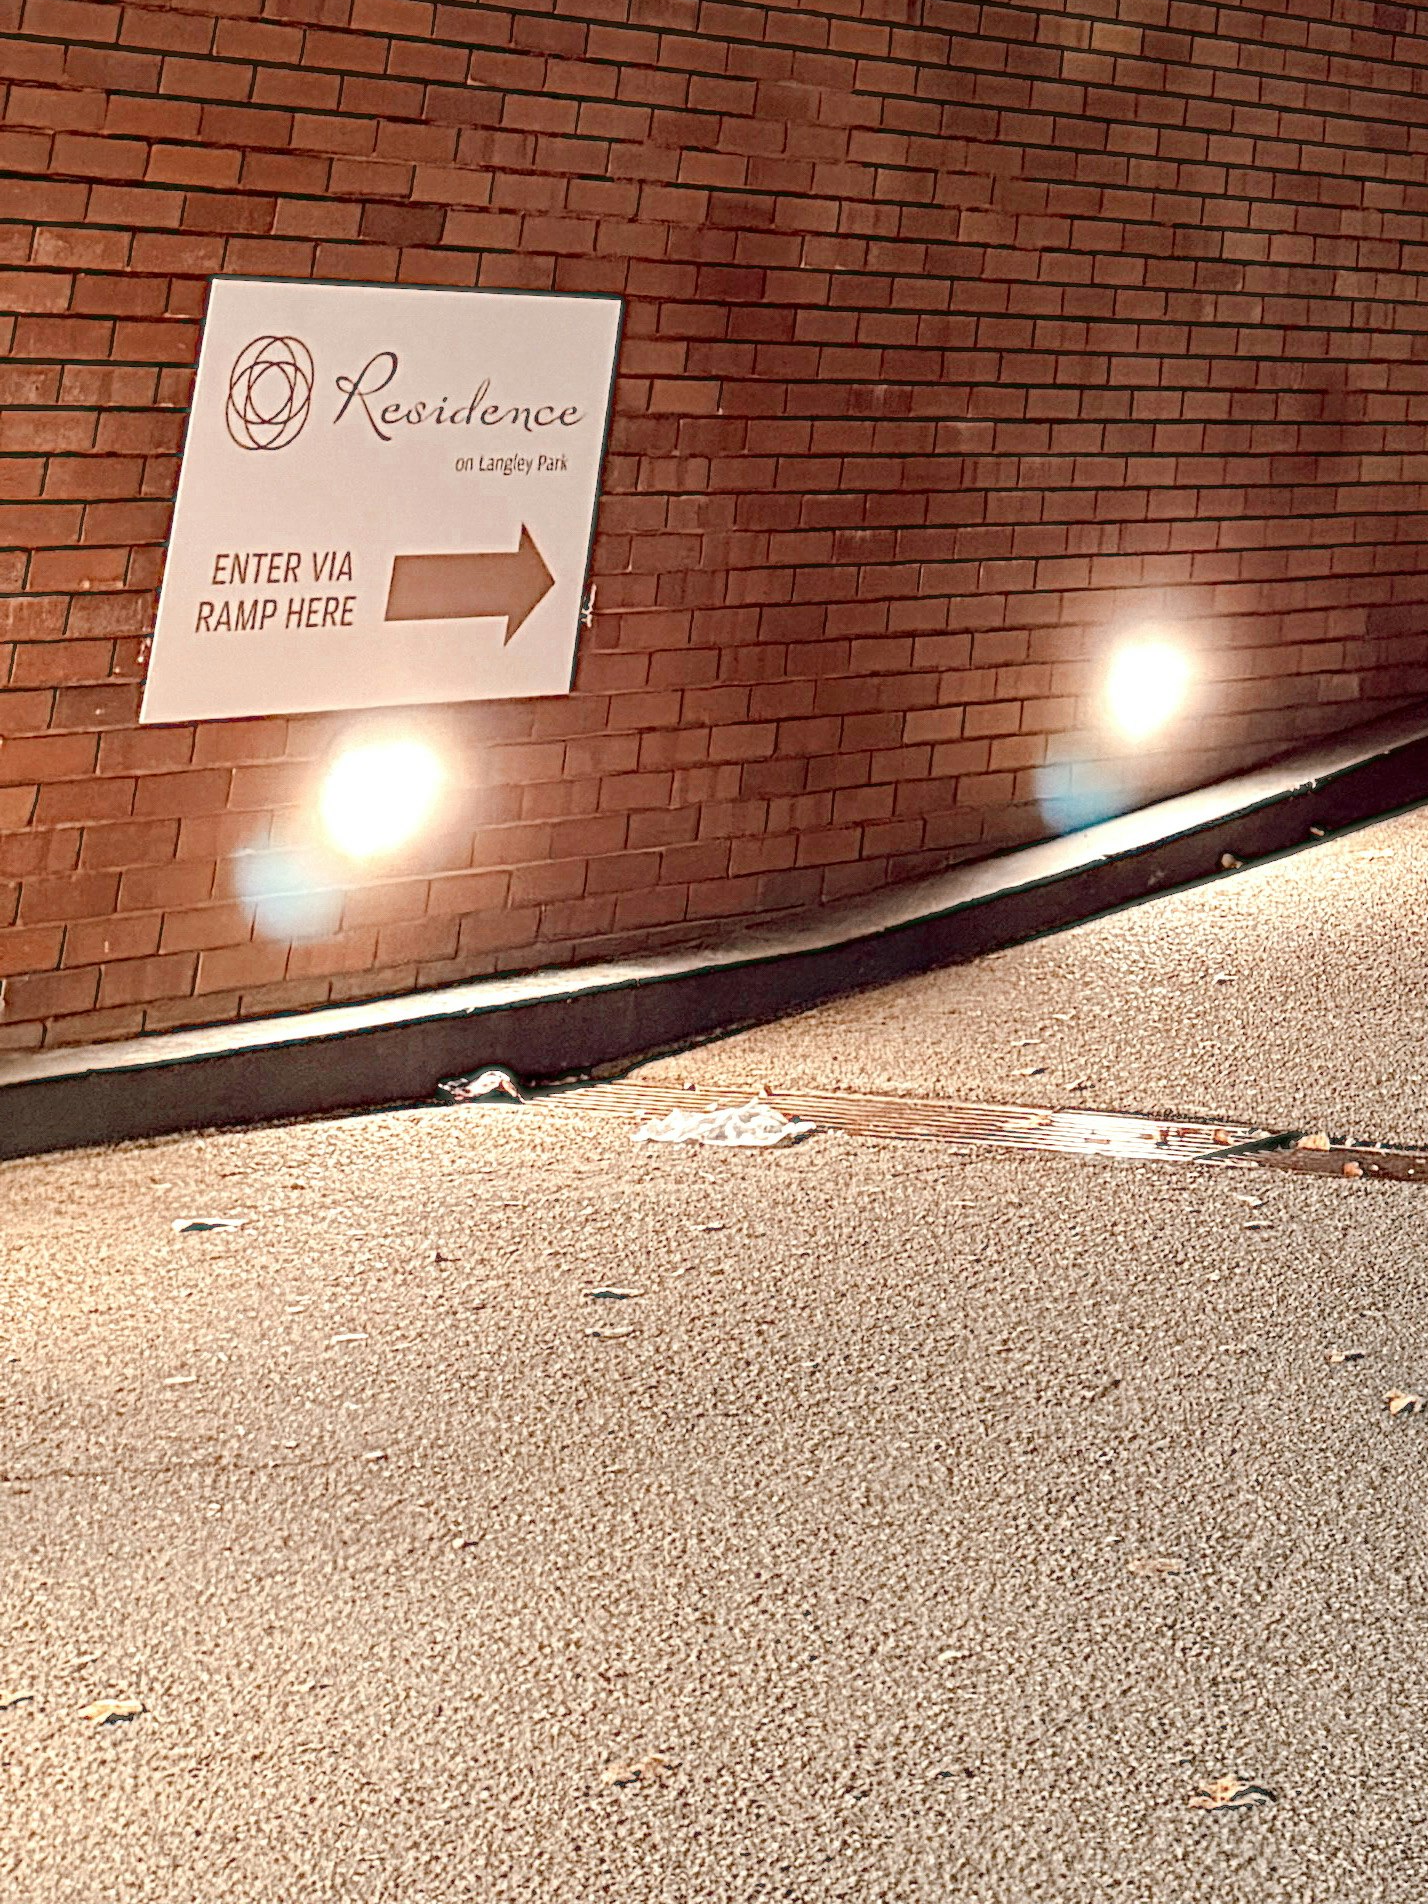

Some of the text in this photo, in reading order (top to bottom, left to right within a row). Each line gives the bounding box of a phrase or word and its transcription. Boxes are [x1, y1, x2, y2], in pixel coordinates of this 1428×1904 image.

[332, 350, 586, 442] Residence
[454, 453, 569, 476] on Langley Park
[211, 550, 354, 586] ENTER VIA
[194, 595, 358, 634] RAMP HERE
